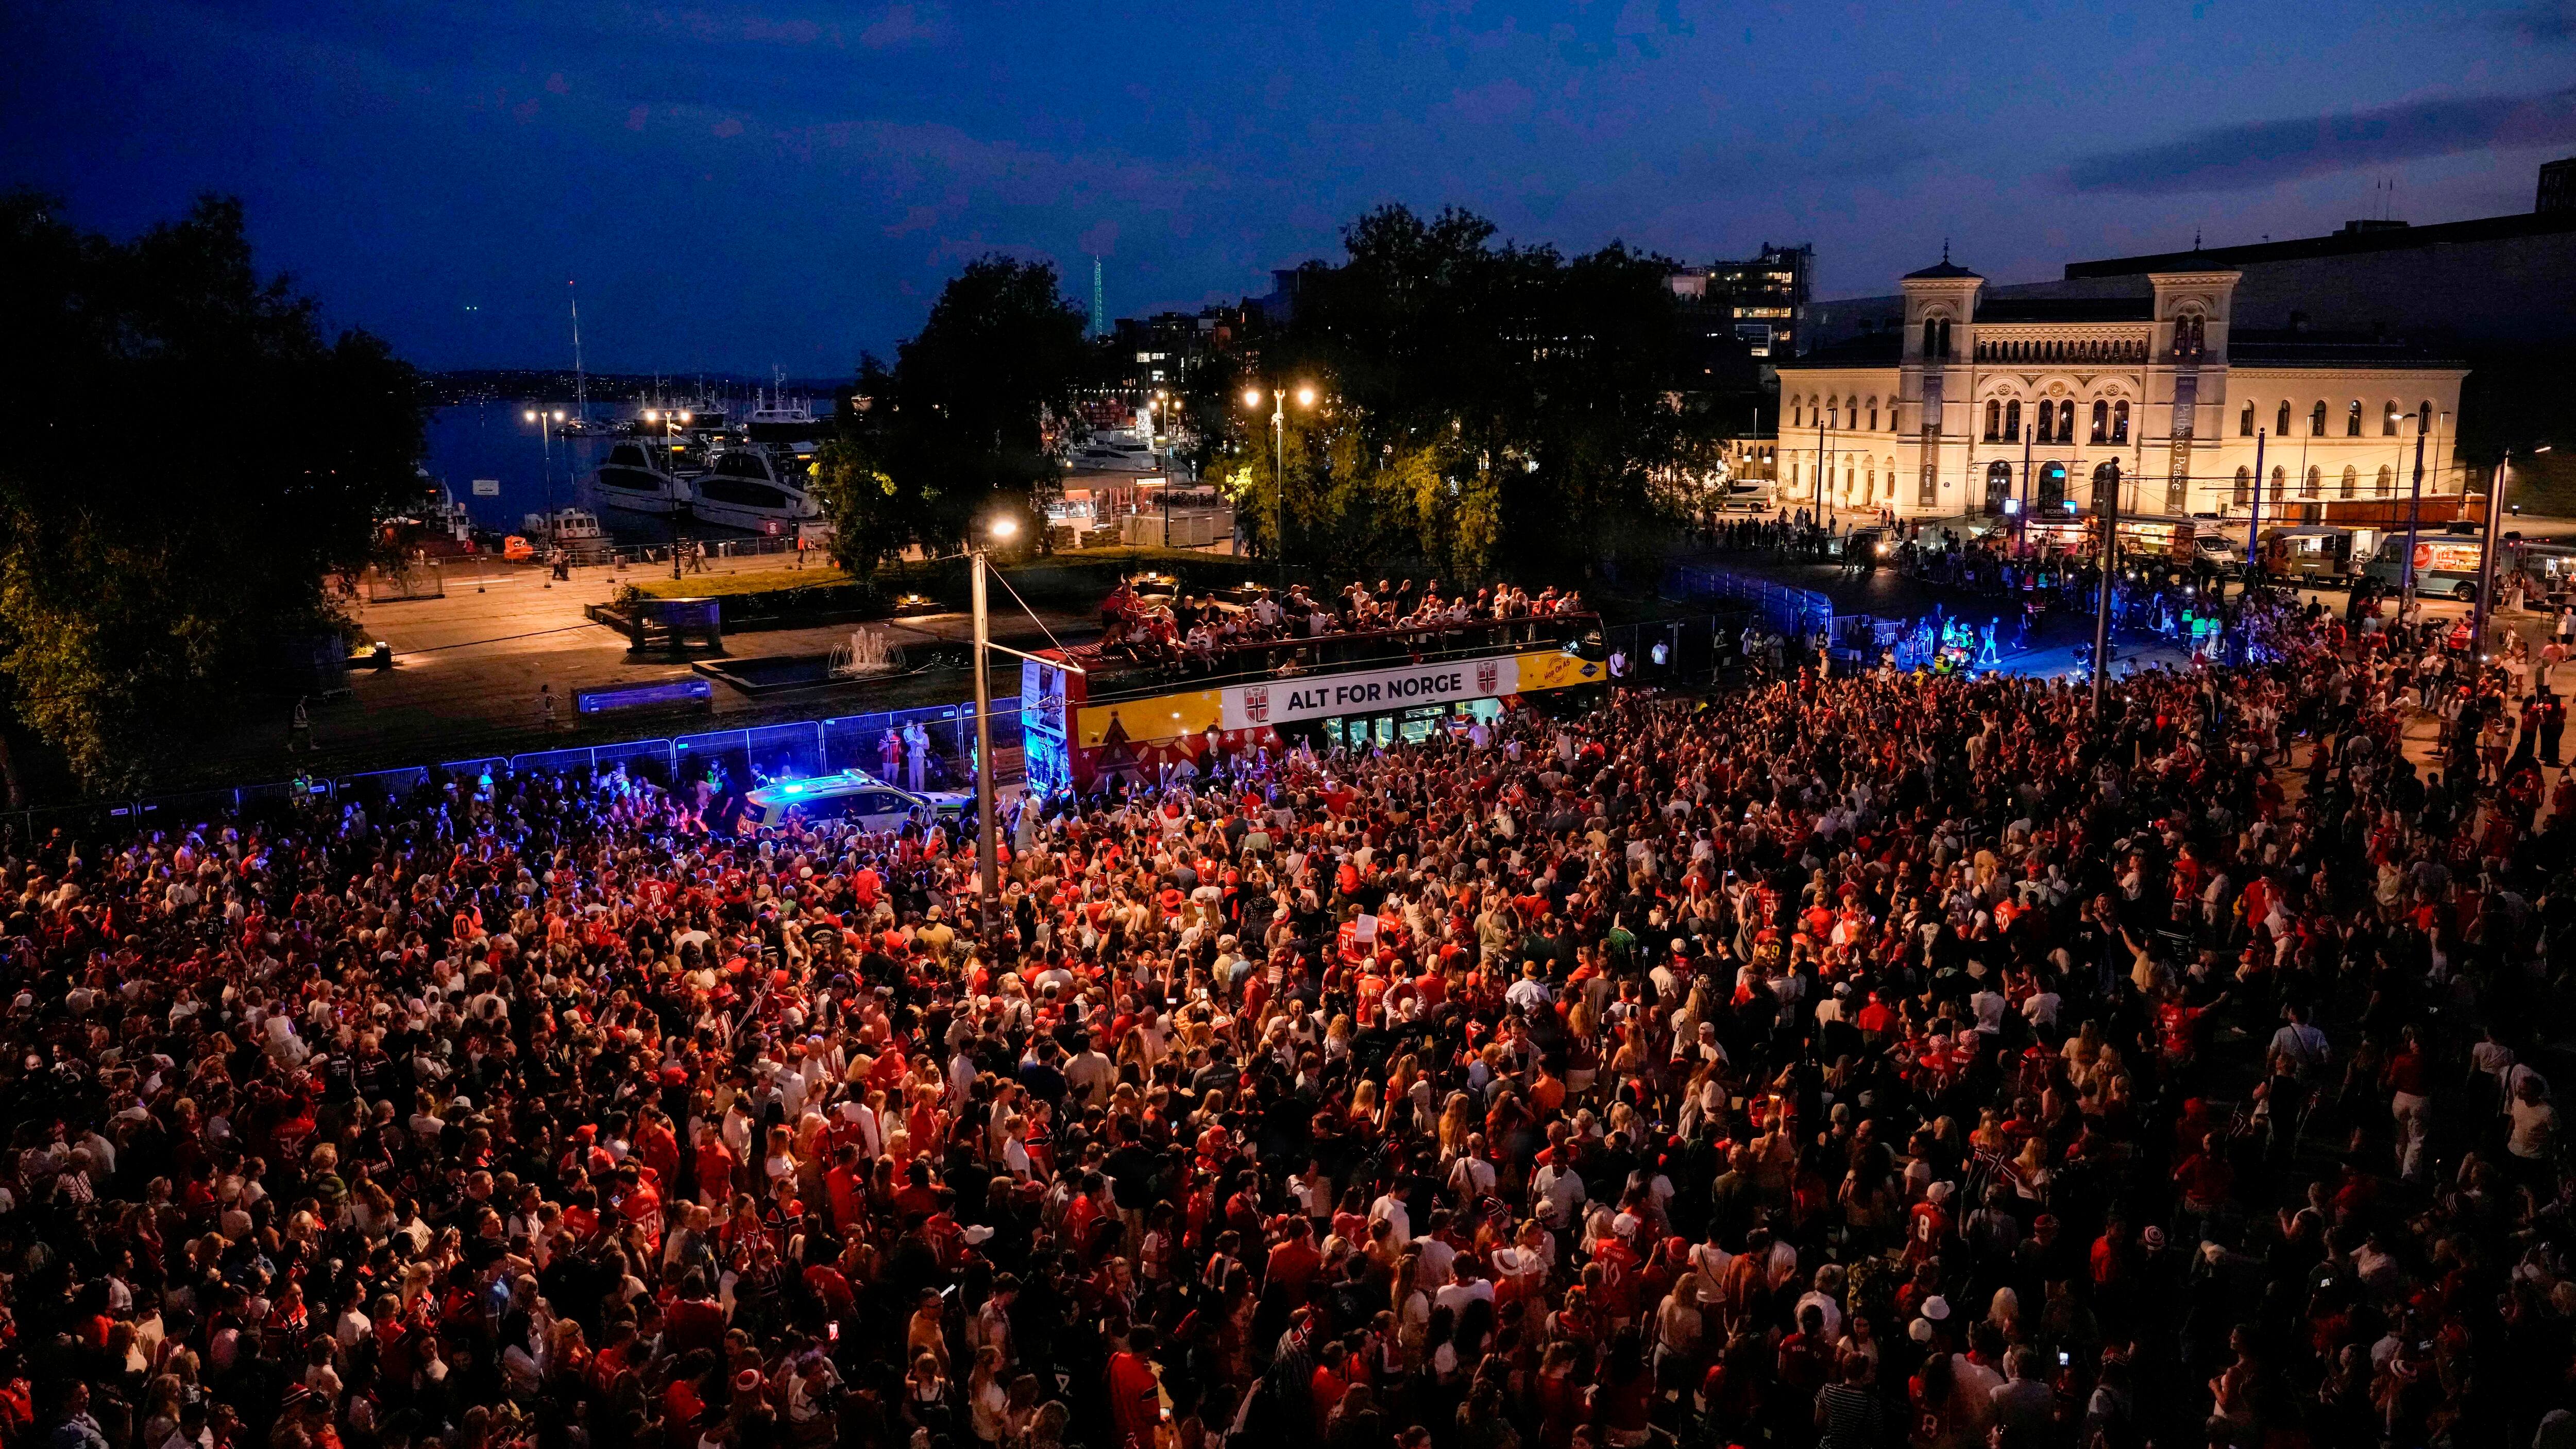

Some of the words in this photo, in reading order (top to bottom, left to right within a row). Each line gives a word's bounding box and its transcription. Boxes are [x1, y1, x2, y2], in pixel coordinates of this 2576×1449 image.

[2177, 404, 2191, 436] Paths
[2175, 439, 2184, 452] to
[2172, 456, 2186, 490] Peace
[1287, 688, 1329, 711] ALT
[1336, 683, 1381, 705] FOR
[1387, 673, 1463, 698] NORGE
[650, 889, 662, 907] 10
[455, 918, 470, 935] 10
[1341, 934, 1354, 951] 21
[1360, 988, 1380, 998] NRGE
[1580, 1036, 1589, 1055] 9
[1918, 1214, 1930, 1242] 8
[1600, 1257, 1621, 1287] 10
